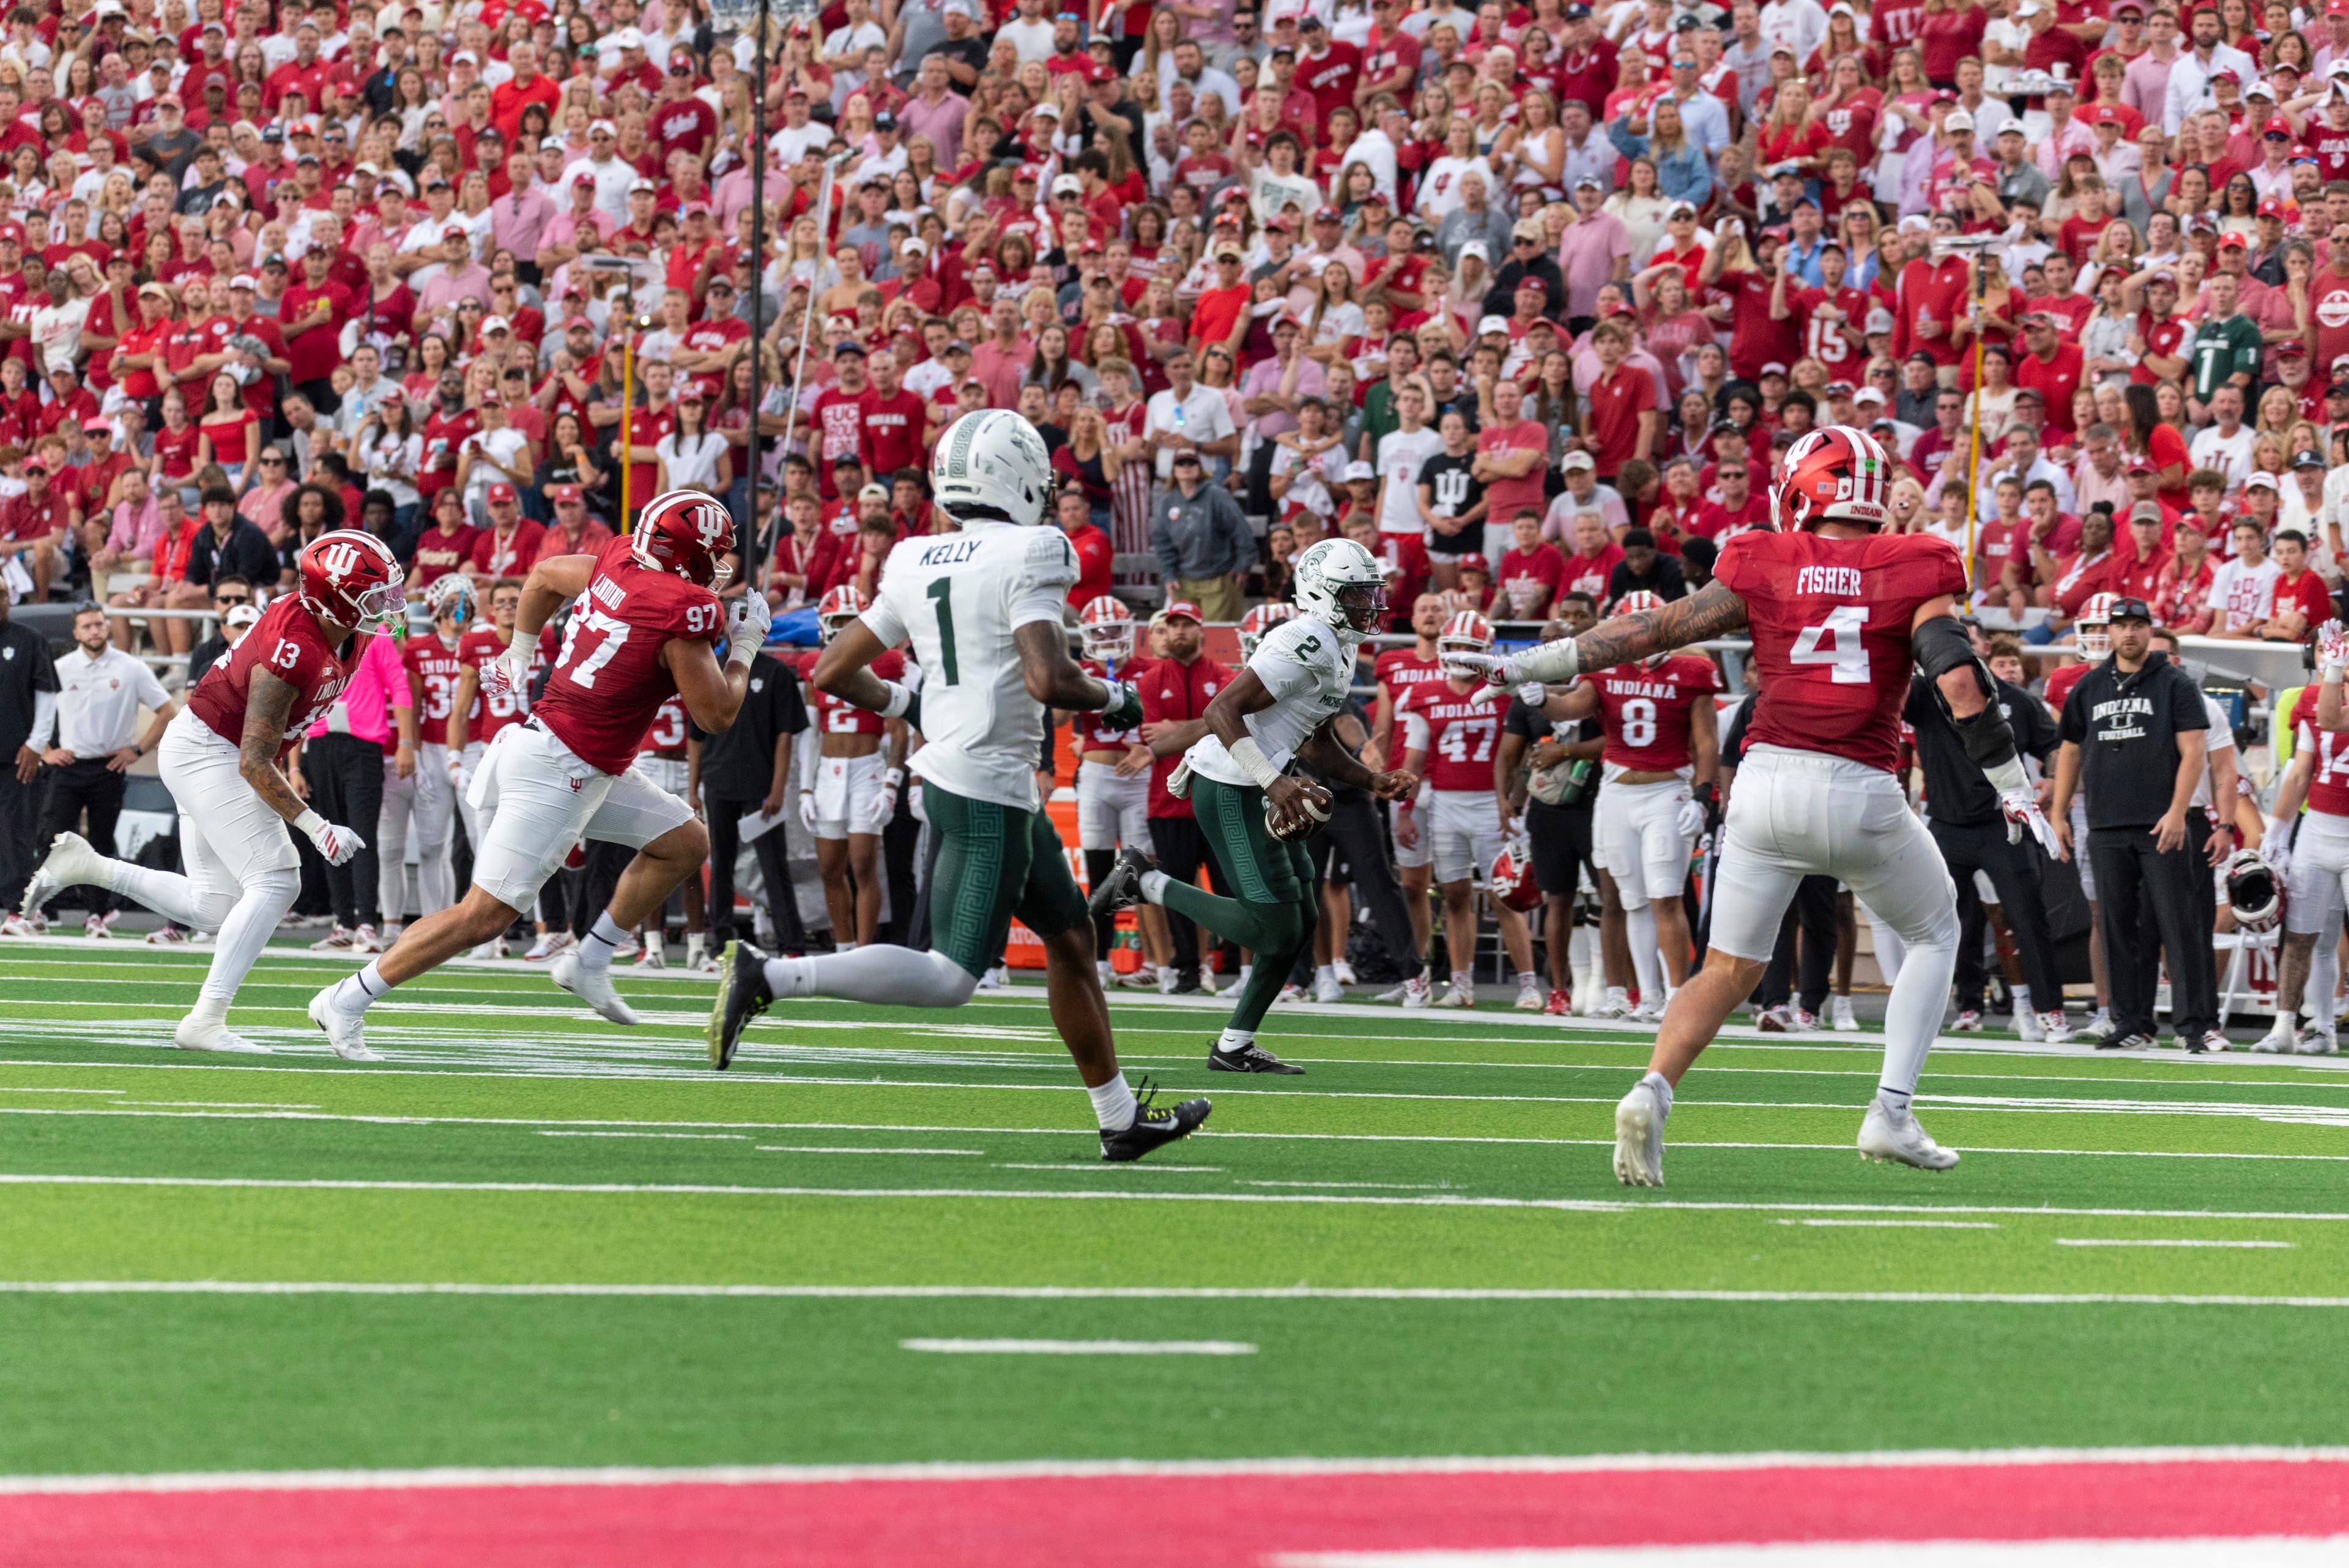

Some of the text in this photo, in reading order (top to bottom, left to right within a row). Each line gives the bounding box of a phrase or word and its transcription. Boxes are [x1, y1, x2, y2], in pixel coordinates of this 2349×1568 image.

[1809, 317, 1847, 362] 15
[2199, 349, 2214, 393] 1
[2248, 347, 2257, 365] 1
[919, 540, 982, 566] KELLY
[1056, 535, 1070, 567] 1
[590, 572, 627, 611] LANDINO
[1796, 565, 1861, 596] FISHER
[686, 603, 717, 633] 97
[926, 575, 959, 686] 1
[270, 637, 300, 669] 13
[1294, 634, 1321, 661] 2
[1790, 605, 1871, 683] 4
[420, 660, 461, 675] INDIA
[313, 671, 358, 701] INDIA
[1606, 679, 1677, 699] INDIANA
[1430, 701, 1498, 719] INDIANA
[1621, 698, 1657, 747] 8
[2091, 697, 2154, 721] INDIANA
[1438, 718, 1497, 762] 47
[2098, 727, 2146, 741] FOOTBALL
